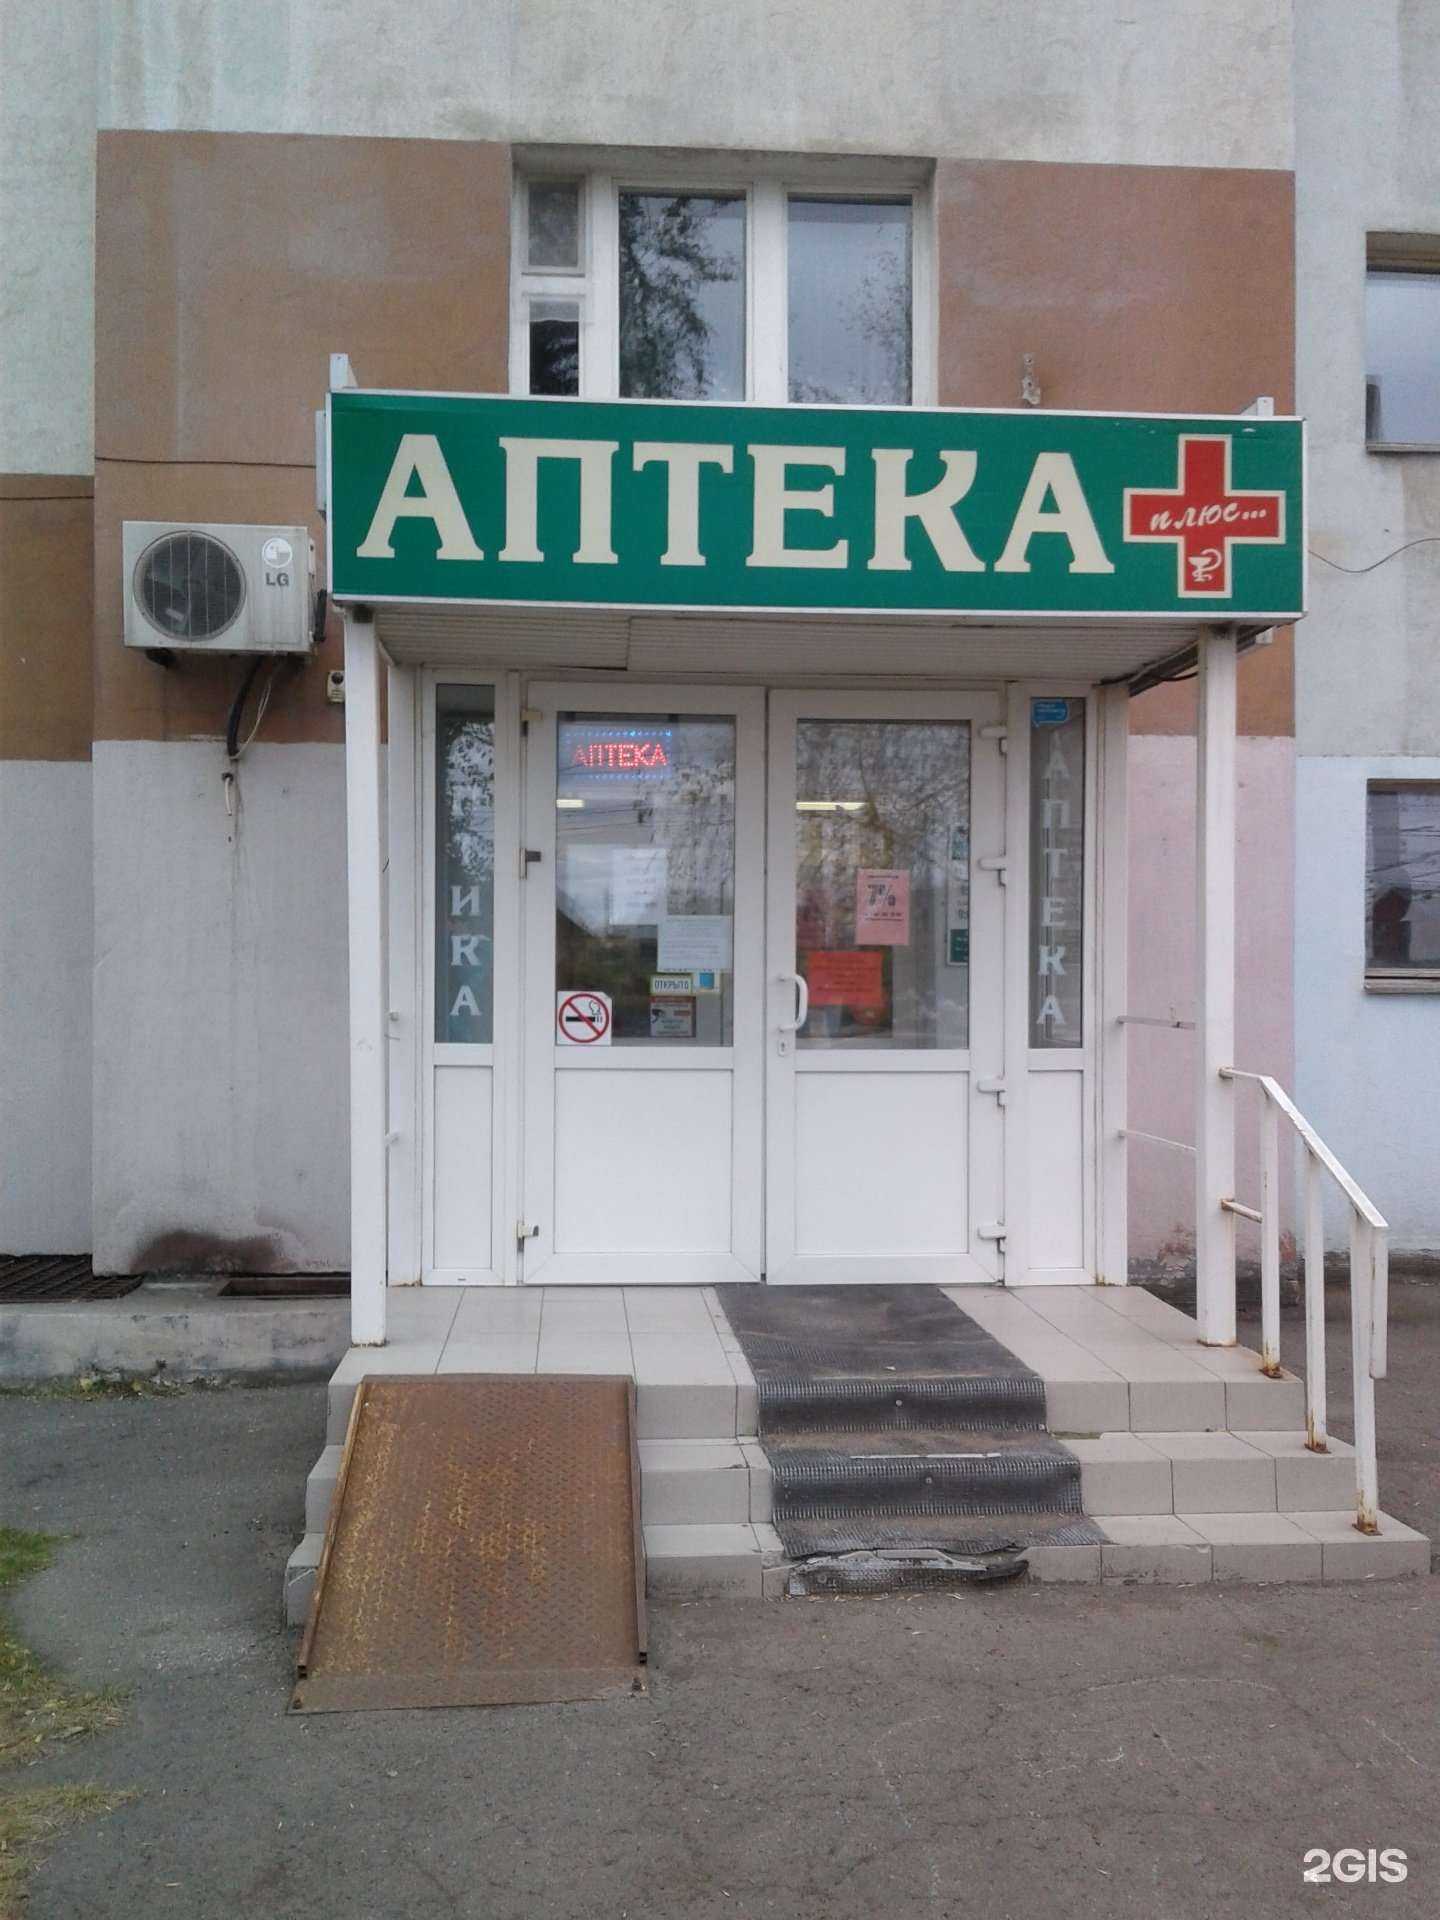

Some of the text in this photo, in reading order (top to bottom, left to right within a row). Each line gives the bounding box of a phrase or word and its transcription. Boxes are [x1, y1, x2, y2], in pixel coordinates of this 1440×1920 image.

[356, 433, 1115, 574] АПТЕКА
[265, 572, 289, 587] LG
[574, 742, 668, 768] АПТЕКА
[1036, 749, 1071, 1025] АПТЕКА
